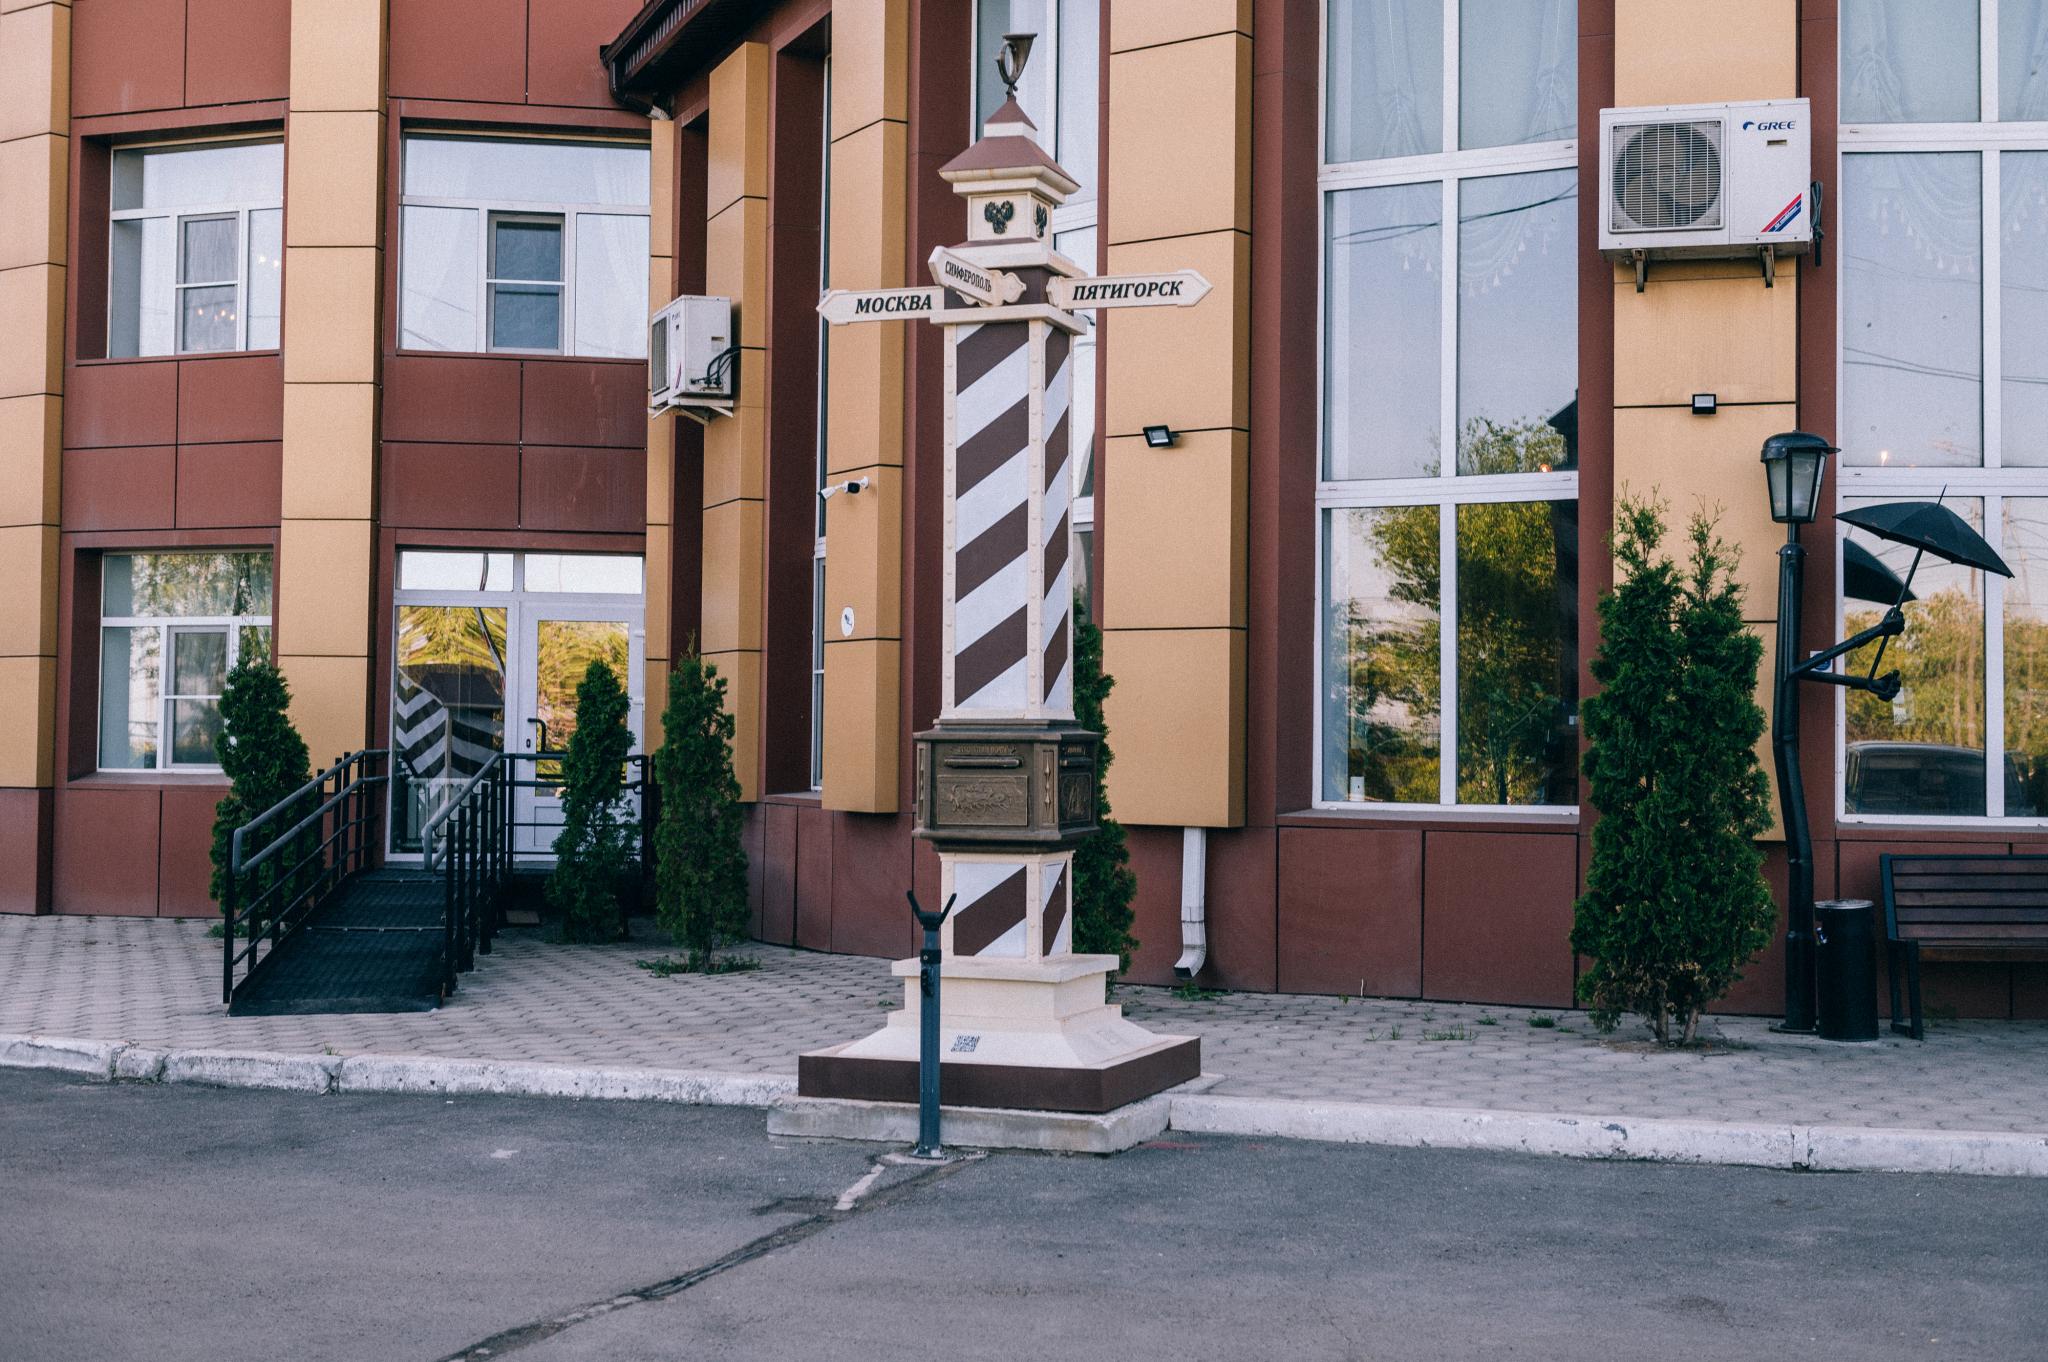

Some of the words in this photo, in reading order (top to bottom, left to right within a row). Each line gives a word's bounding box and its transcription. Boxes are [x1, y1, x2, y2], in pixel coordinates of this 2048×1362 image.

[1757, 120, 1797, 131] GREE
[945, 260, 992, 293] СИМФЕРОПОЛЬ
[1072, 280, 1184, 301] ПЯТИГОРСК
[854, 294, 933, 314] МОСКВА
